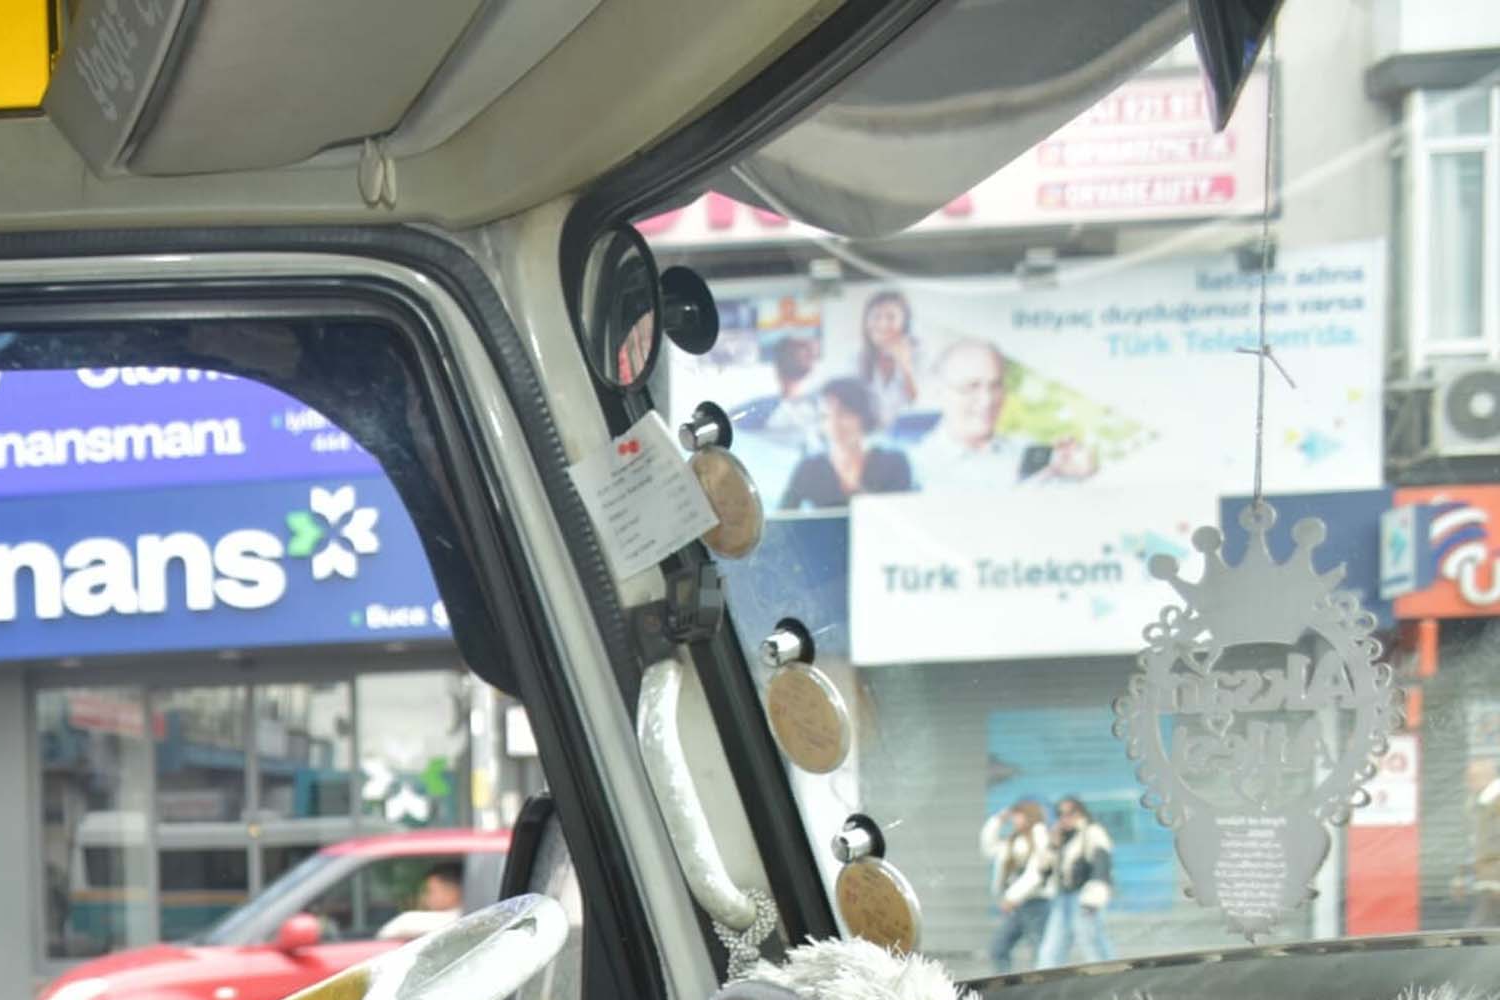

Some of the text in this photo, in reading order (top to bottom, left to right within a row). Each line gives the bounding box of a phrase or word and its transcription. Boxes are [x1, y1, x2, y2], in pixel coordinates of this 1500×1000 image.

[1106, 331, 1173, 356] Türk
[881, 555, 1124, 593] Türk Telekom
